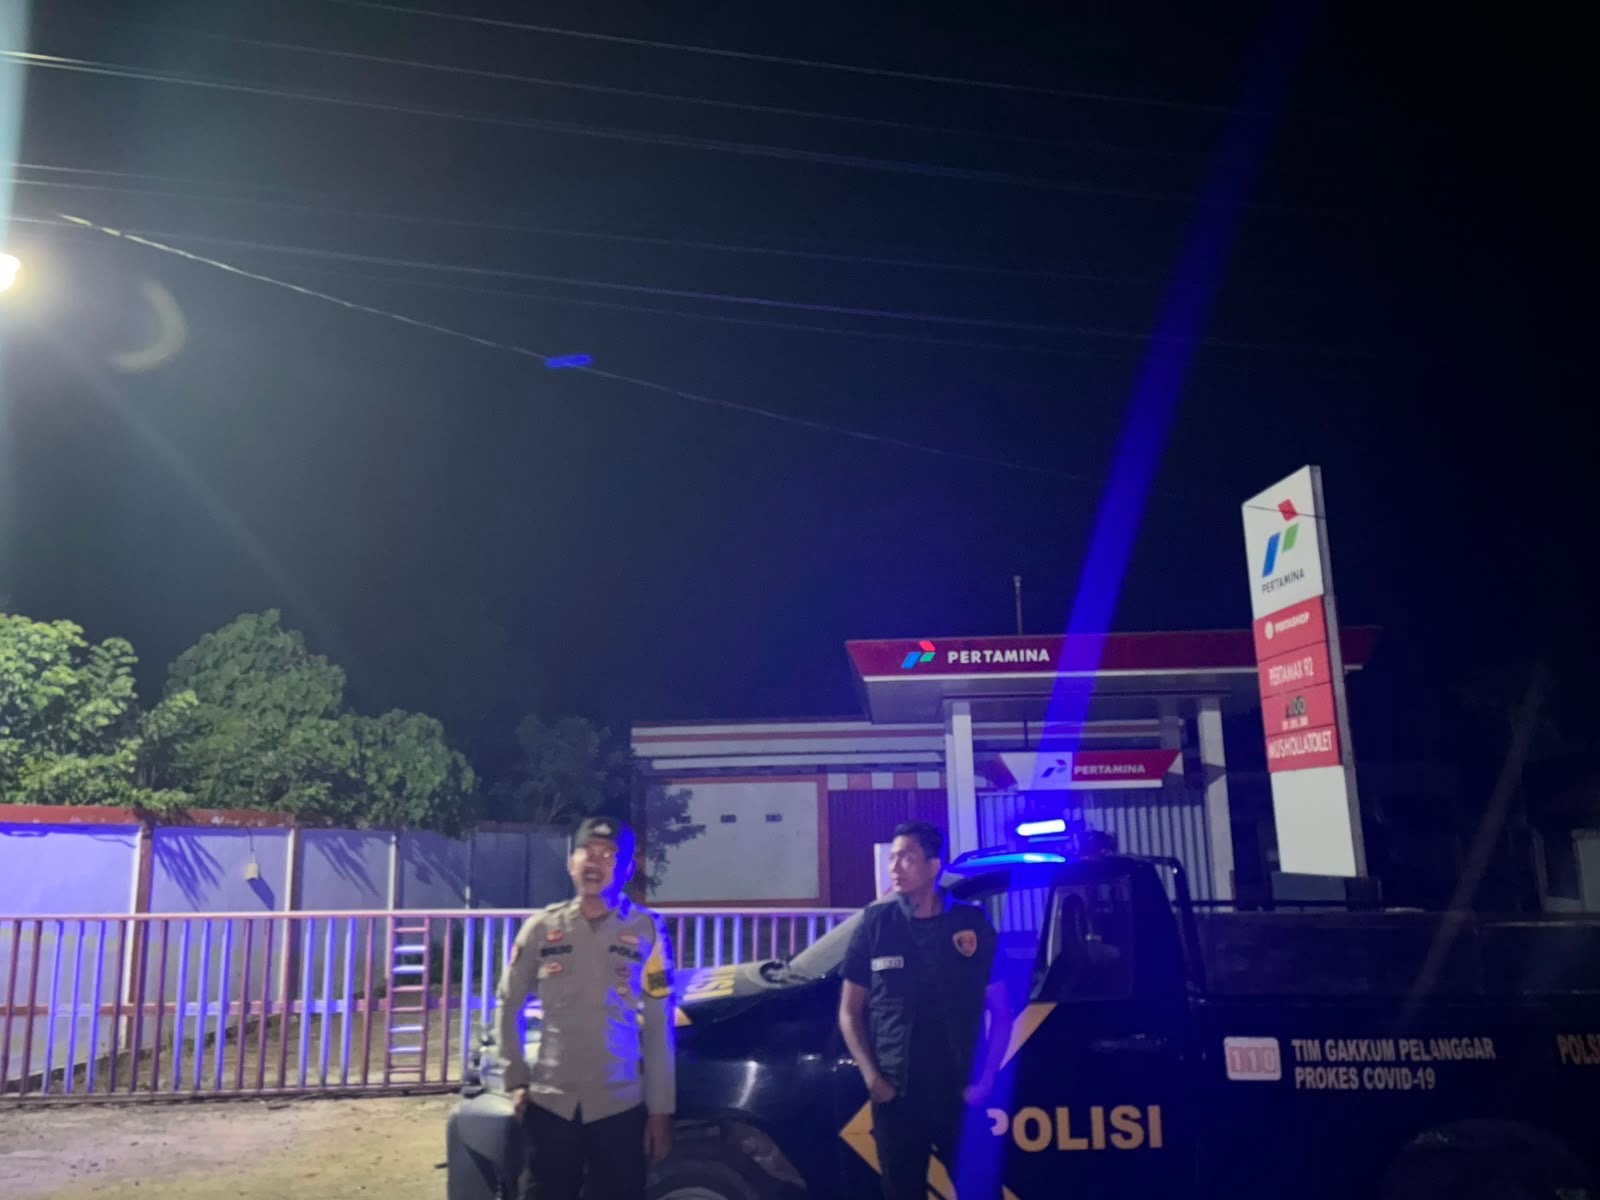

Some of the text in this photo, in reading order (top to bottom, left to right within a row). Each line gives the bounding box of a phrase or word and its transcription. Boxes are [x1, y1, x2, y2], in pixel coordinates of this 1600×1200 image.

[1261, 568, 1305, 595] PERTAMINA
[947, 648, 1050, 664] PERTAMINA
[1074, 763, 1146, 775] PERTAMINA
[1231, 1049, 1276, 1071] 110
[1291, 1037, 1496, 1062] TIM GAKKUM PELANGGAR
[1556, 1034, 1600, 1065] POLS
[1294, 1067, 1436, 1090] PROKES COVID-19
